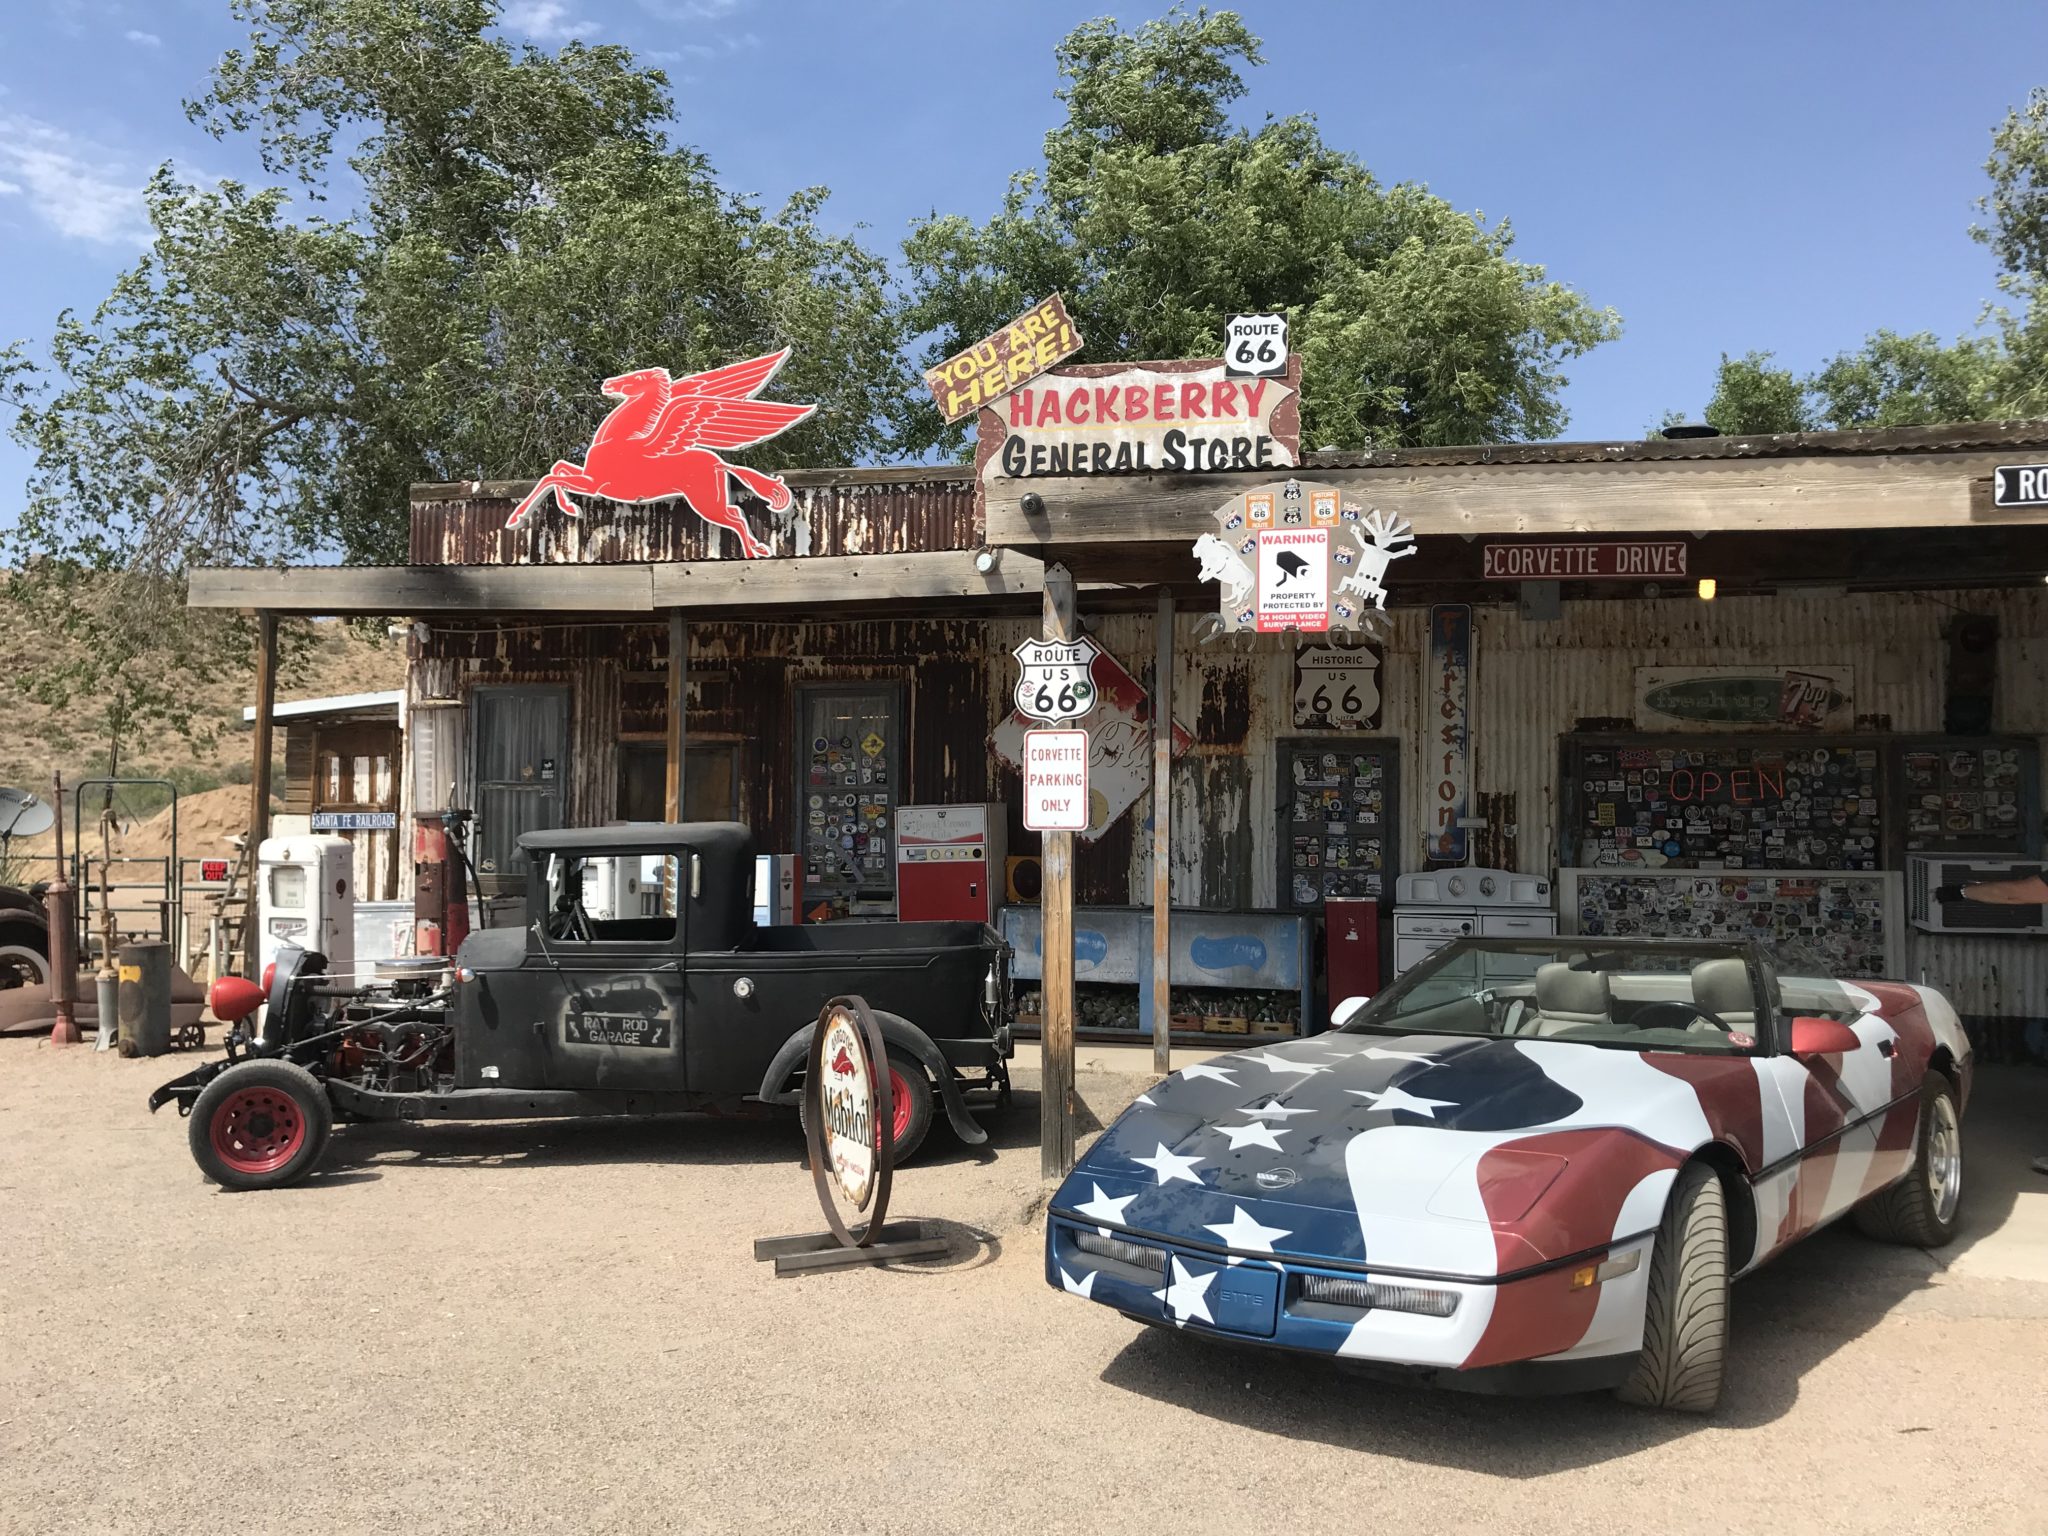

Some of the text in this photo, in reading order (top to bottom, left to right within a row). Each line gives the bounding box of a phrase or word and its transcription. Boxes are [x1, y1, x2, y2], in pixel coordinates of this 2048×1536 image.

[1234, 323, 1279, 336] ROUTE
[936, 304, 1060, 388] YOU ARE
[1235, 339, 1276, 363] 66
[947, 323, 1072, 416] HERE!
[1009, 378, 1267, 428] HACKBERRY
[1002, 428, 1273, 476] GENERAL STORE
[1343, 511, 1355, 520] 66
[1228, 519, 1241, 529] 66
[1262, 534, 1326, 545] WARNING
[1243, 543, 1255, 553] 66
[1336, 555, 1348, 564] 66
[1493, 546, 1677, 575] CORVETTE DRIVE
[1240, 613, 1252, 623] 66
[1336, 606, 1348, 617] 66
[1034, 648, 1081, 662] ROUTE
[1312, 656, 1363, 664] HISTORIC
[1034, 683, 1077, 713] 66
[1312, 684, 1362, 714] 66
[1031, 748, 1081, 761] CORVETTE
[1030, 774, 1082, 786] PARKING
[1669, 767, 1785, 801] OPEN
[1041, 799, 1071, 812] ONLY
[316, 813, 392, 828] SANTA FE RAILROAD
[203, 862, 227, 872] KEEP
[205, 871, 224, 880] OUT
[584, 1016, 648, 1031] RAT ROD
[589, 1030, 640, 1044] GARAGE
